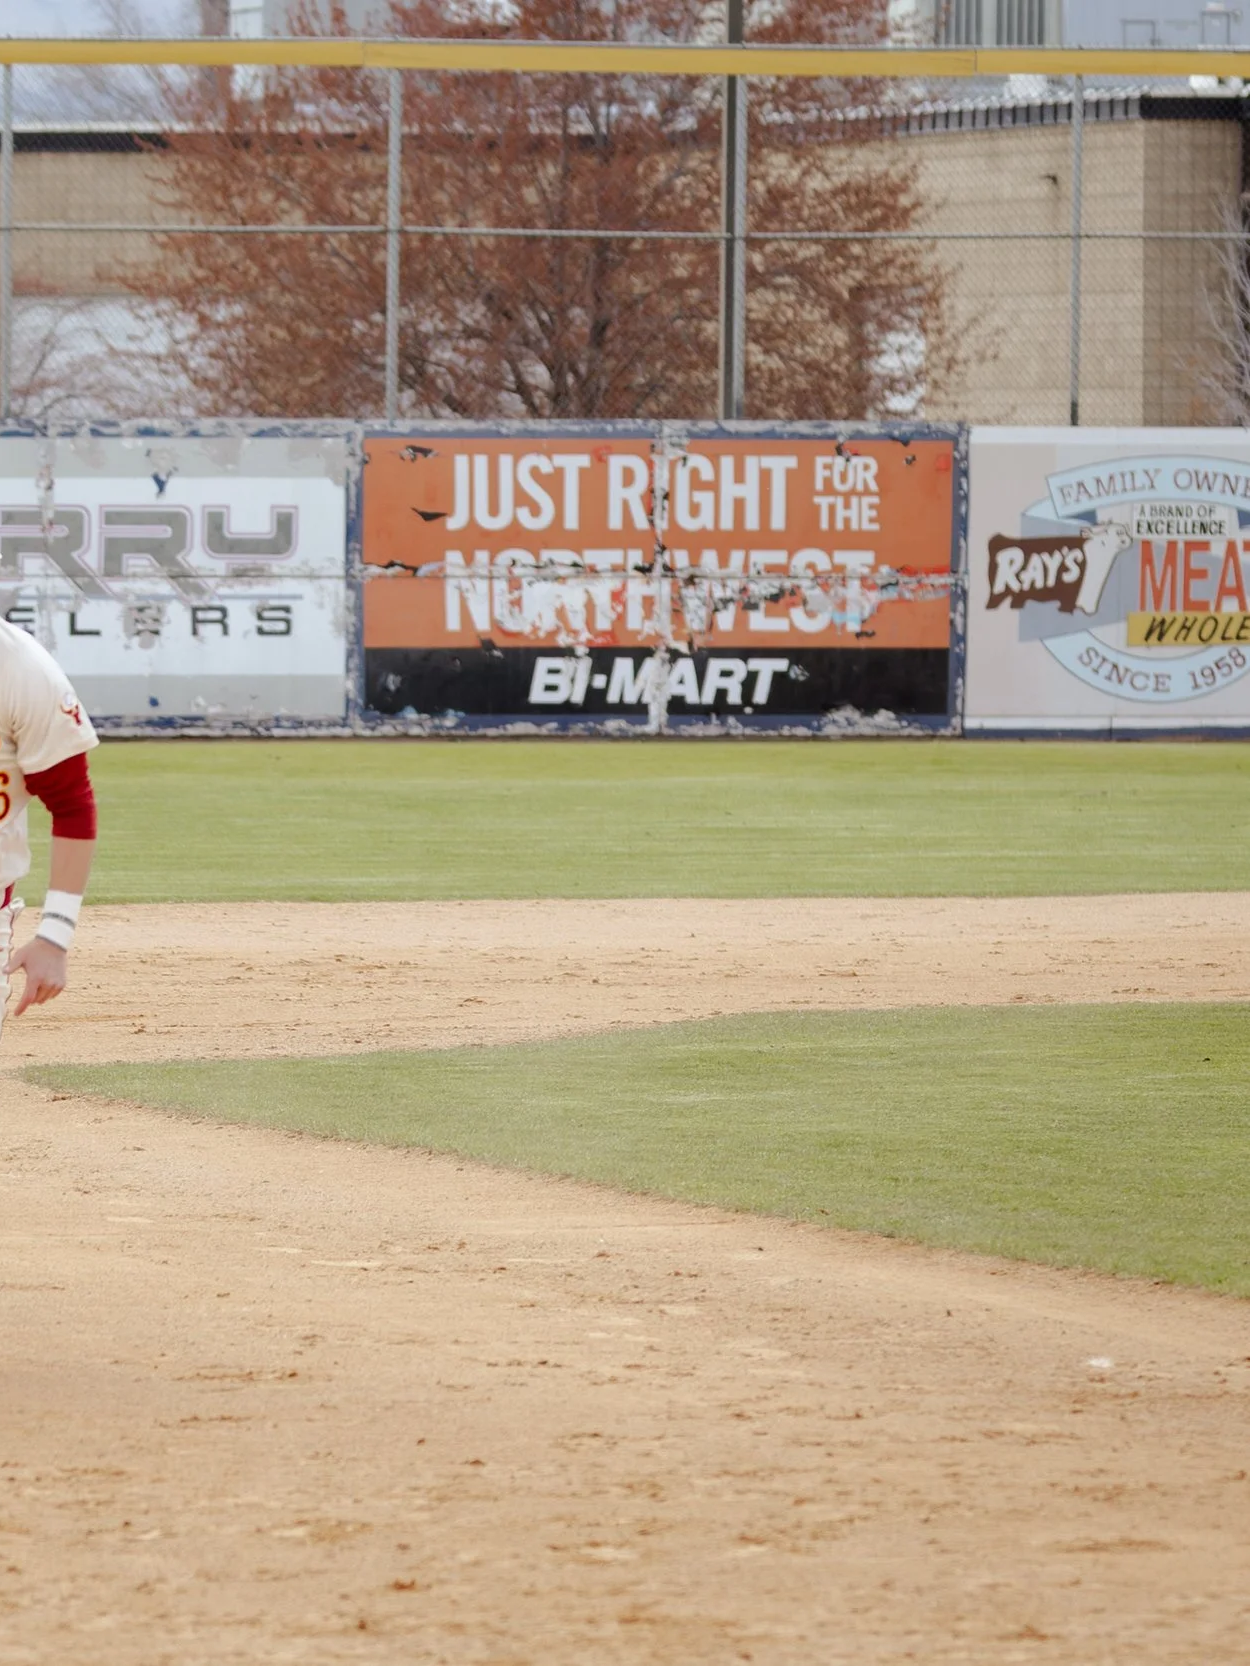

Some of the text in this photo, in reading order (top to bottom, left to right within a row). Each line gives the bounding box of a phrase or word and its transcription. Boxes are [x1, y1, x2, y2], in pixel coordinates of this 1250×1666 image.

[446, 453, 797, 532] JUST RIGHT
[813, 455, 878, 492] FOR
[1057, 468, 1162, 505] FAMILY
[813, 495, 880, 532] THE
[1136, 520, 1227, 536] EXCELLENCE
[1139, 504, 1216, 518] A BRAND OF
[444, 548, 877, 634] NORTHWEST
[992, 546, 1084, 595] RAY'S
[1139, 538, 1250, 613] MEA
[1078, 647, 1247, 693] SINCE 1958
